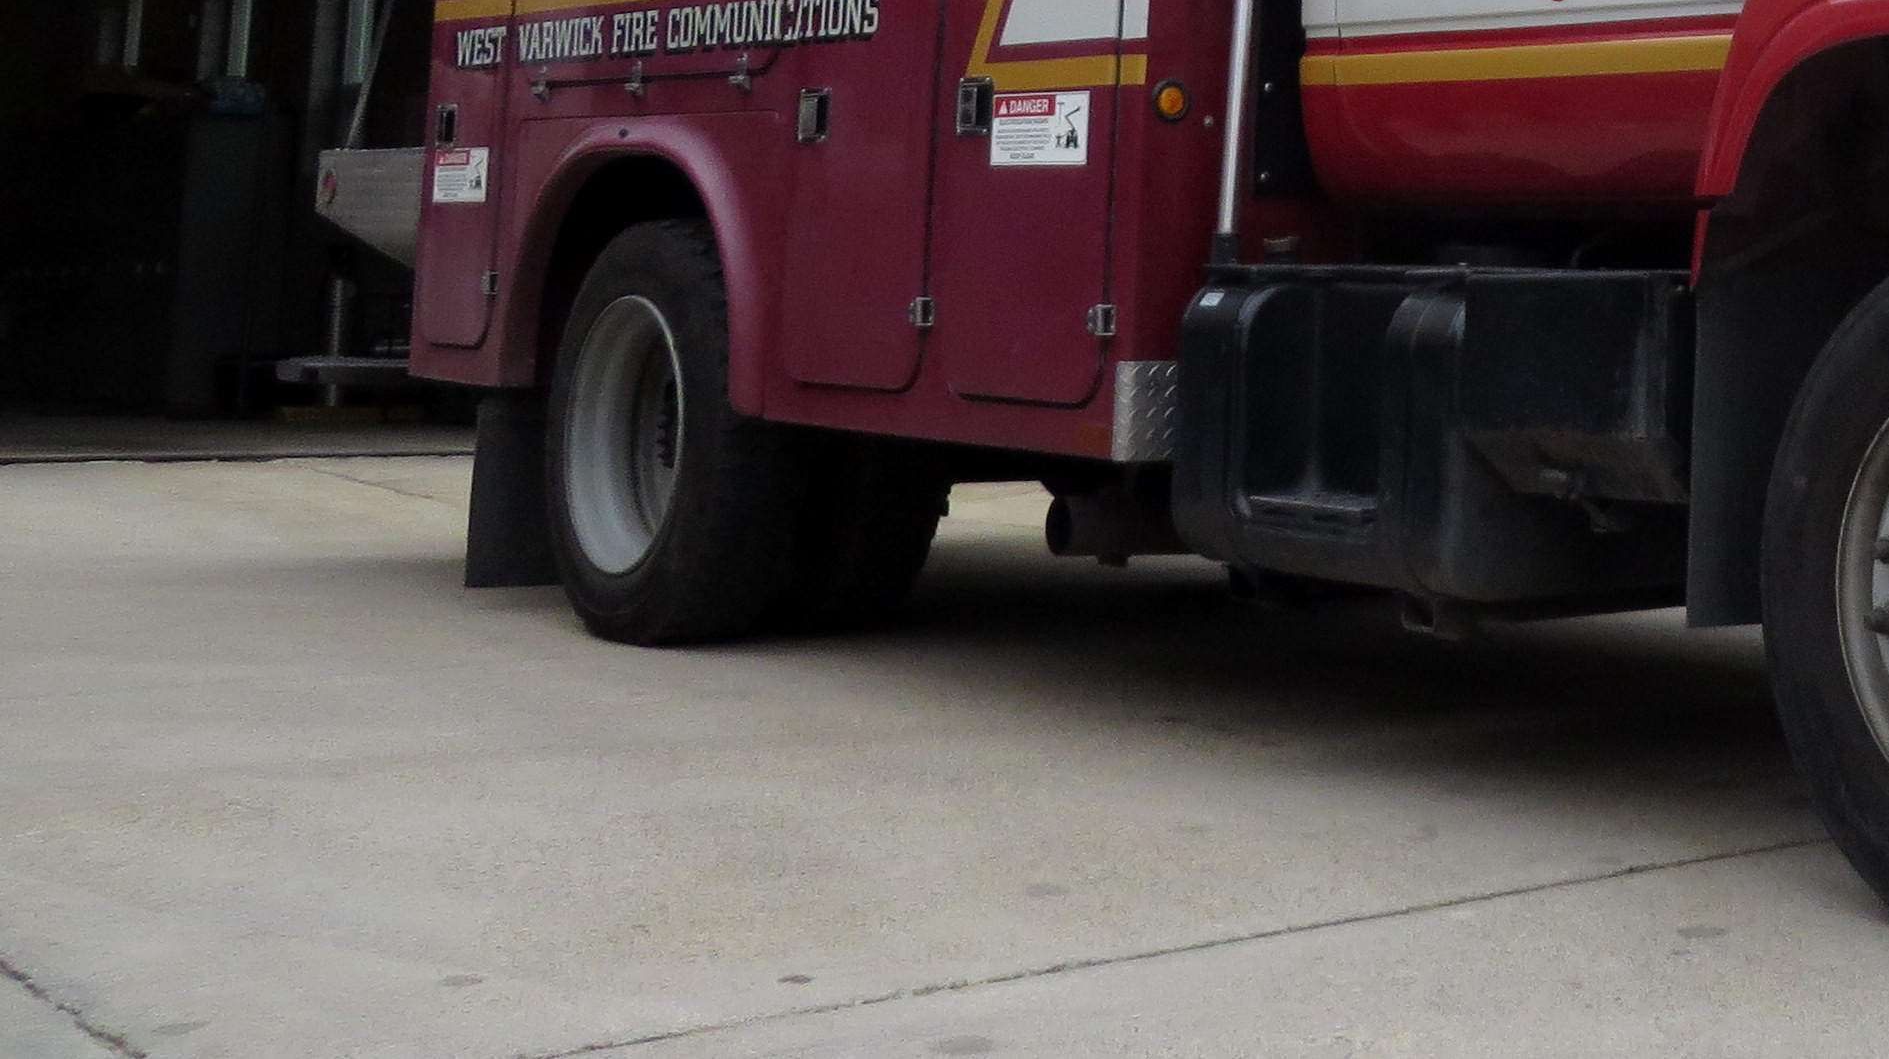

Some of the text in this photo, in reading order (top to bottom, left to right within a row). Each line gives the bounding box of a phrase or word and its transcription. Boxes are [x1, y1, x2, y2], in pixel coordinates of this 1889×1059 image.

[456, 25, 508, 67] WEST
[610, 8, 660, 54] FIRE
[1008, 98, 1050, 114] DANGER
